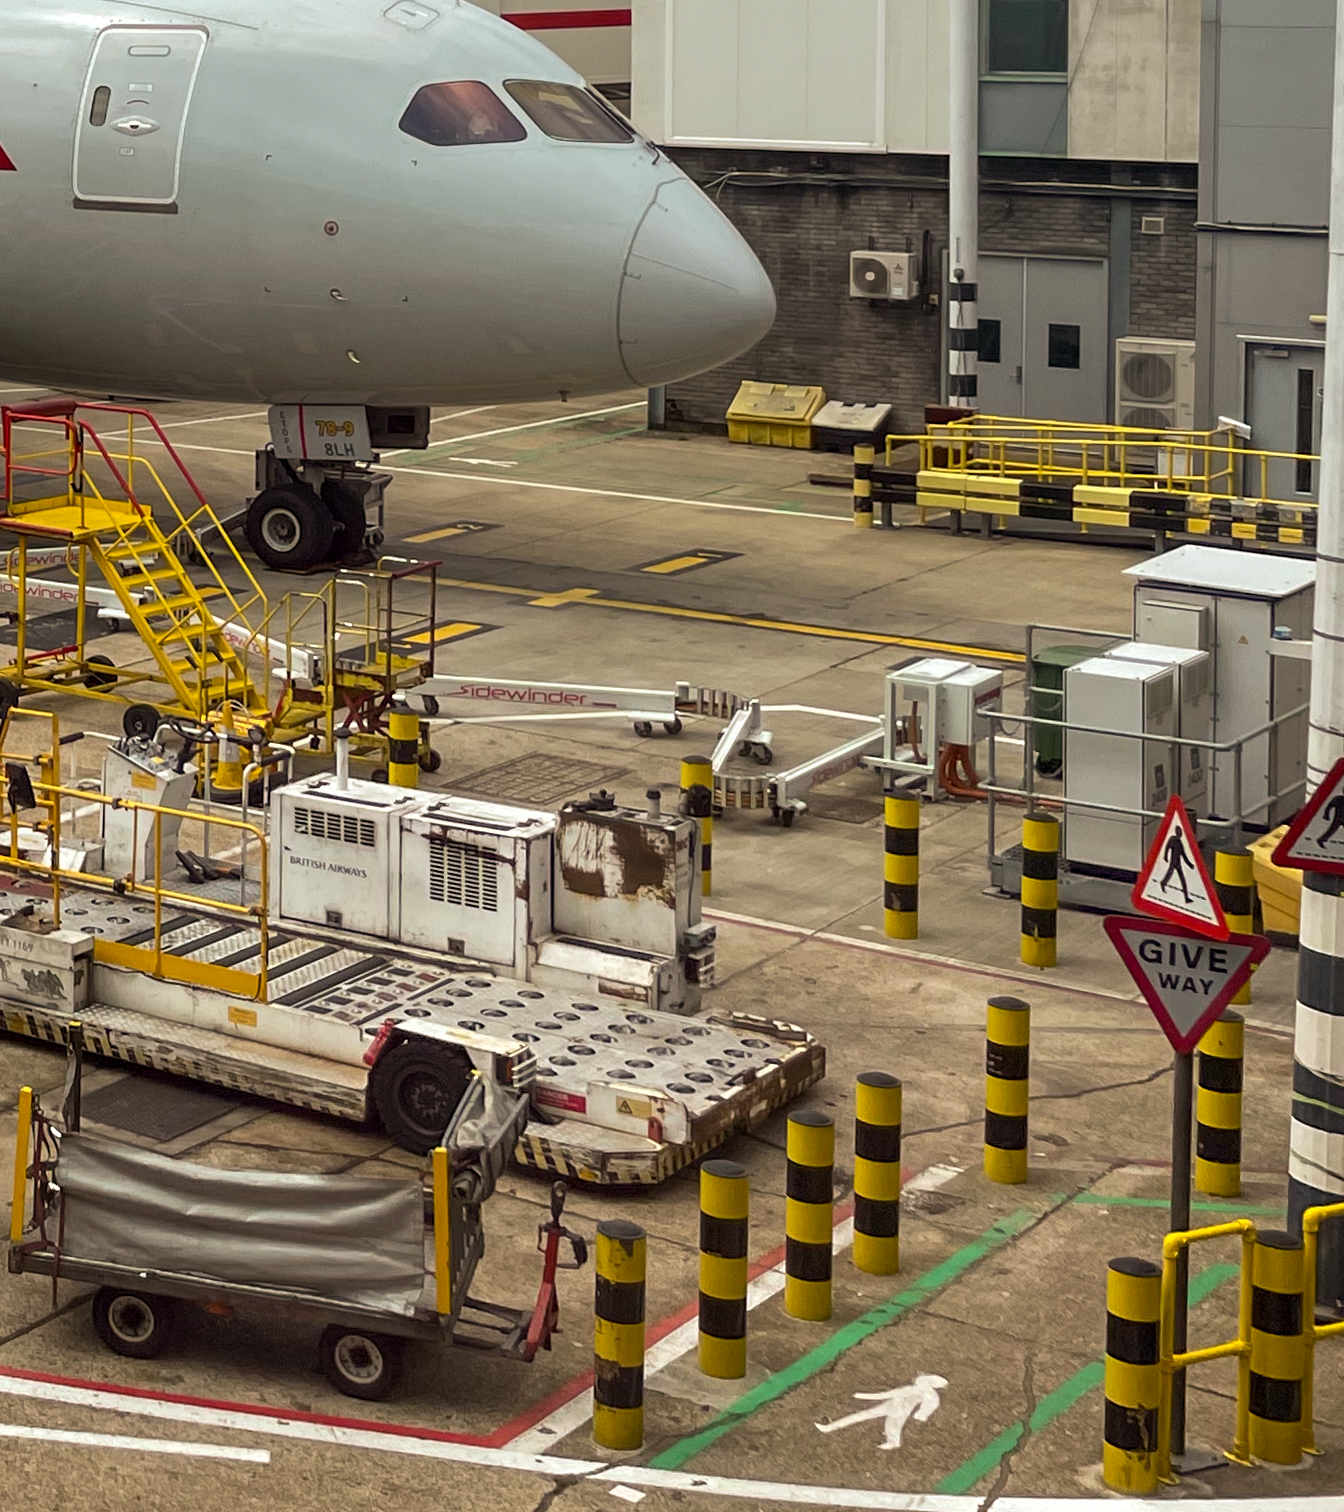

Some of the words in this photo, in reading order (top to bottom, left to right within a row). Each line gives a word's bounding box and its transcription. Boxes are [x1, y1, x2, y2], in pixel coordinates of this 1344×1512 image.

[314, 419, 355, 438] 78-9
[324, 443, 355, 457] 8LH
[447, 684, 587, 706] Sidewinder
[289, 855, 326, 870] BRITISH
[328, 863, 367, 879] AIRWAYS
[1139, 939, 1228, 974] GIVE
[1158, 972, 1213, 995] WAY
